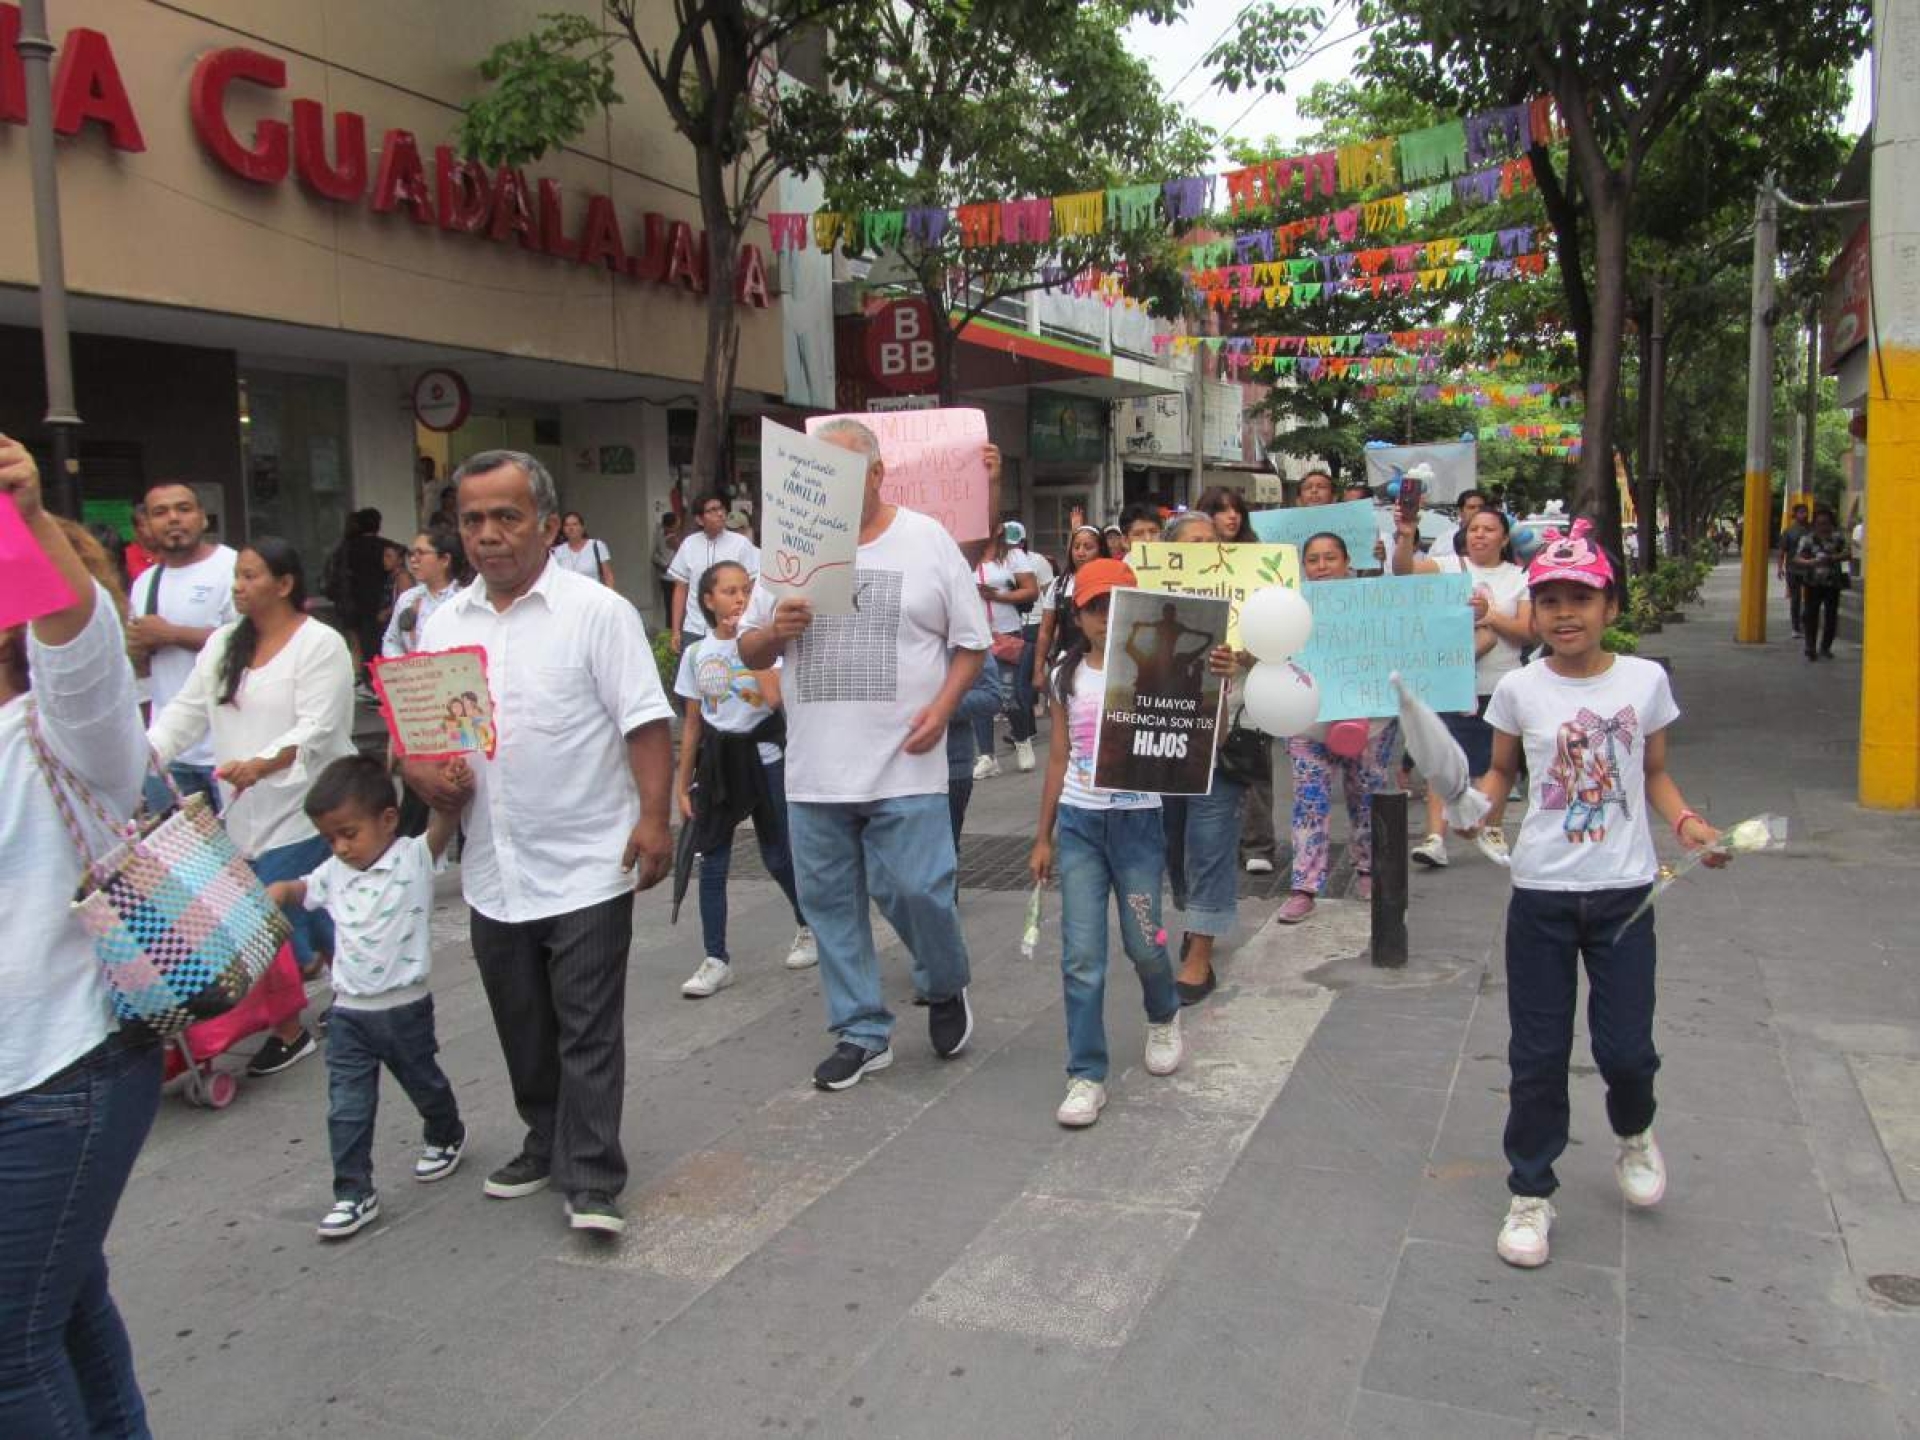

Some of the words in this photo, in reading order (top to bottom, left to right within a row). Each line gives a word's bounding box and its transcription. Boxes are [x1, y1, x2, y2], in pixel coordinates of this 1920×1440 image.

[190, 47, 768, 309] GUADALAJAA
[783, 478, 828, 509] FAMILIA
[781, 532, 816, 557] UNIDOS
[1136, 544, 1184, 571] La
[1136, 695, 1153, 708] TU
[1154, 697, 1197, 712] MAYOR
[1106, 710, 1167, 727] HERENCIA
[1170, 716, 1194, 729] SON
[1196, 717, 1215, 730] TUS
[1132, 729, 1190, 759] HIJOS
